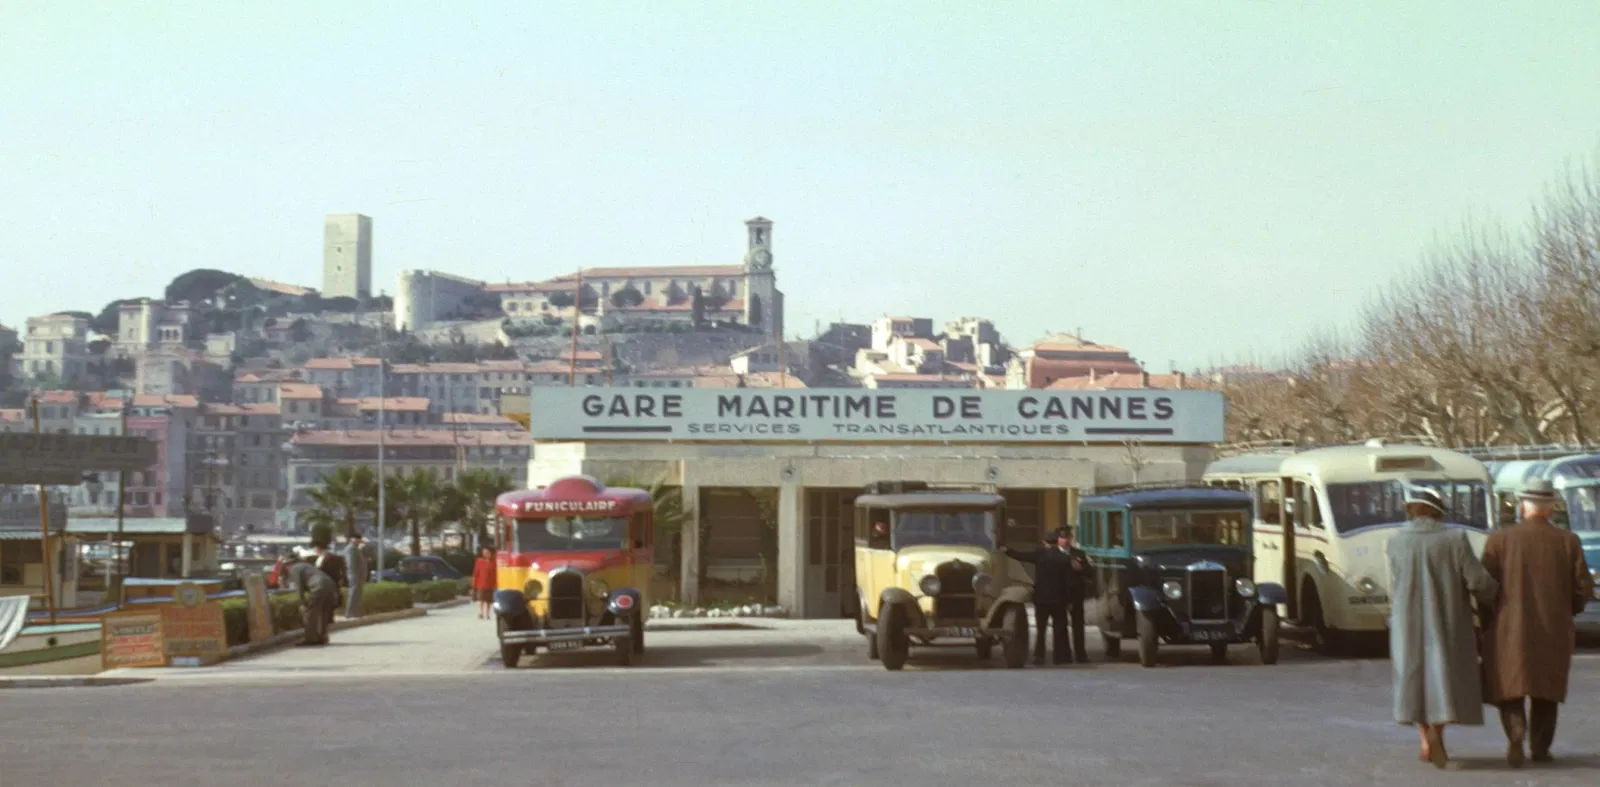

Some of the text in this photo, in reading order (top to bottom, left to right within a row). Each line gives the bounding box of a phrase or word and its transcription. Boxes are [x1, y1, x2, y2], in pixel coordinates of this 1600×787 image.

[581, 394, 1175, 420] GARE MARITIME DE CANNES
[687, 423, 1070, 436] SERVICES TRANSATLANTIQUES
[524, 500, 617, 513] FUNICULAIRE
